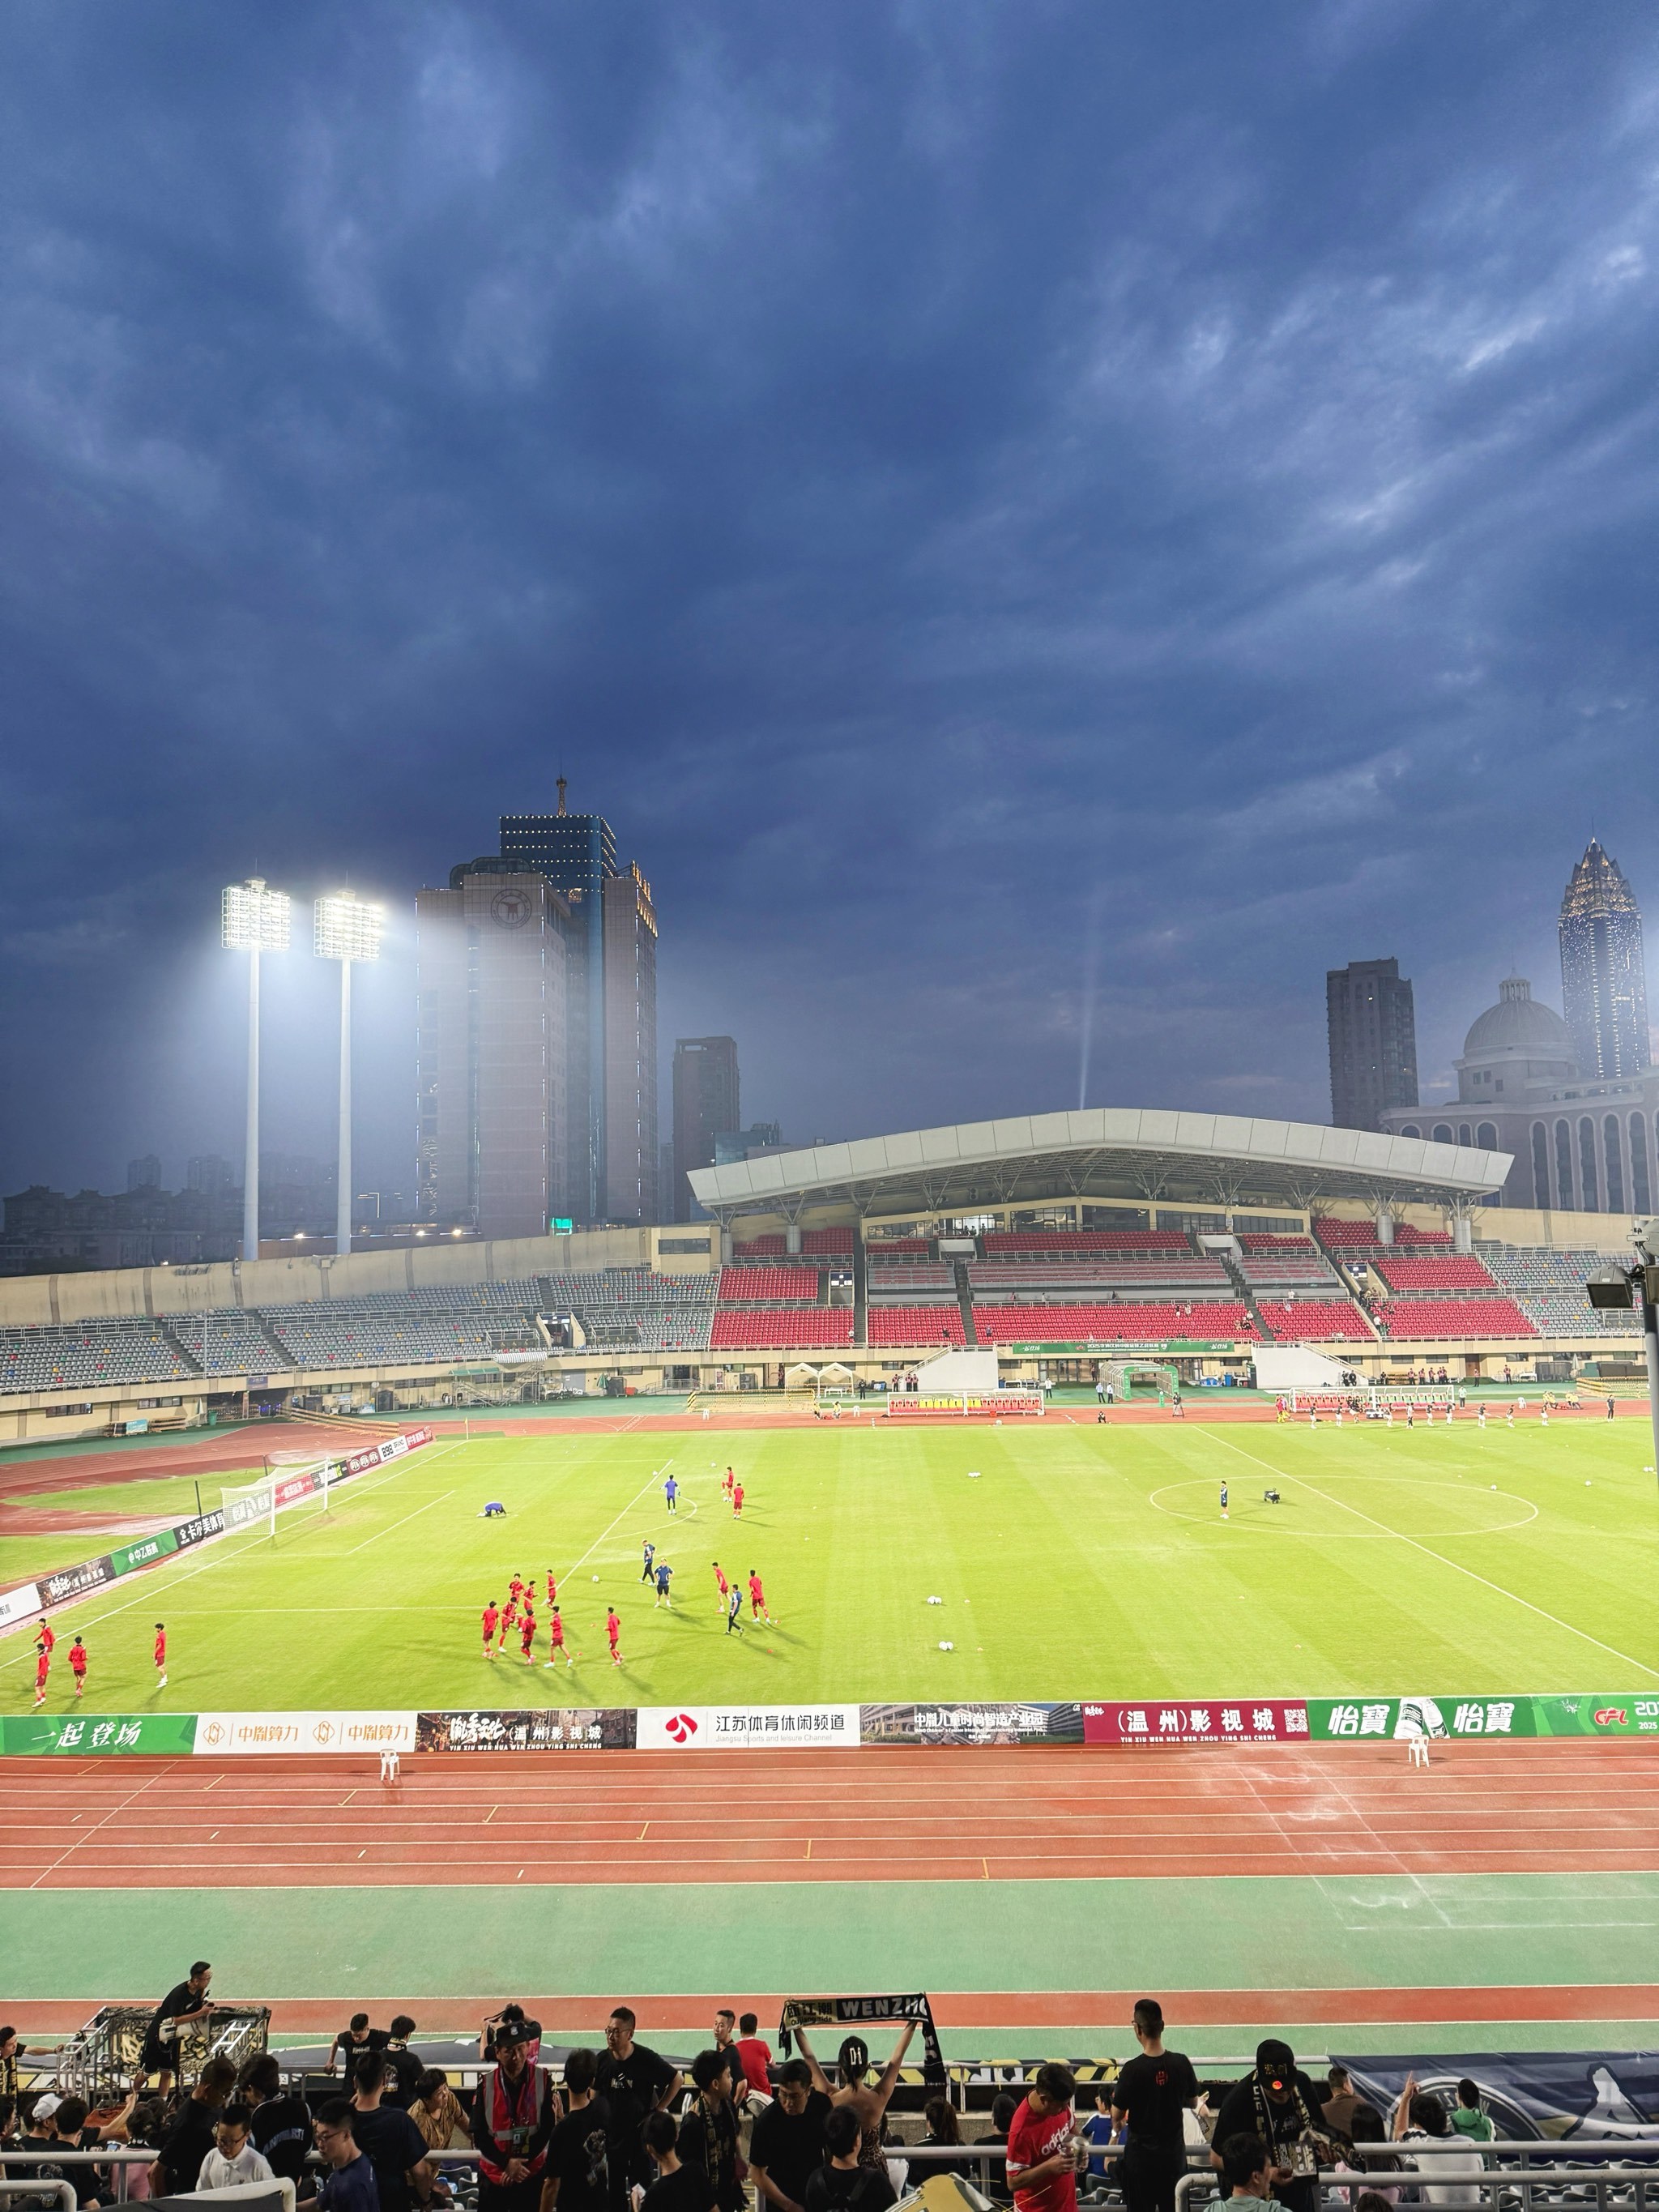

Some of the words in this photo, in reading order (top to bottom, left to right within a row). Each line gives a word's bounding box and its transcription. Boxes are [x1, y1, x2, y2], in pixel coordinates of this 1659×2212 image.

[1452, 1702, 1516, 1733] 怡寶
[1633, 1702, 1659, 1716] 20
[715, 1714, 845, 1732] 江苏体育休闲频道
[1328, 1704, 1391, 1735] 怡寶
[1638, 1722, 1658, 1730] 2025
[31, 1720, 143, 1749] 一起登场
[237, 1725, 299, 1743] 中胤算力
[348, 1724, 409, 1742] 中胤算力
[715, 1735, 741, 1744] Jiangsu
[743, 1734, 765, 1743] Sports
[766, 1734, 778, 1742] and
[804, 1733, 832, 1741] Channel
